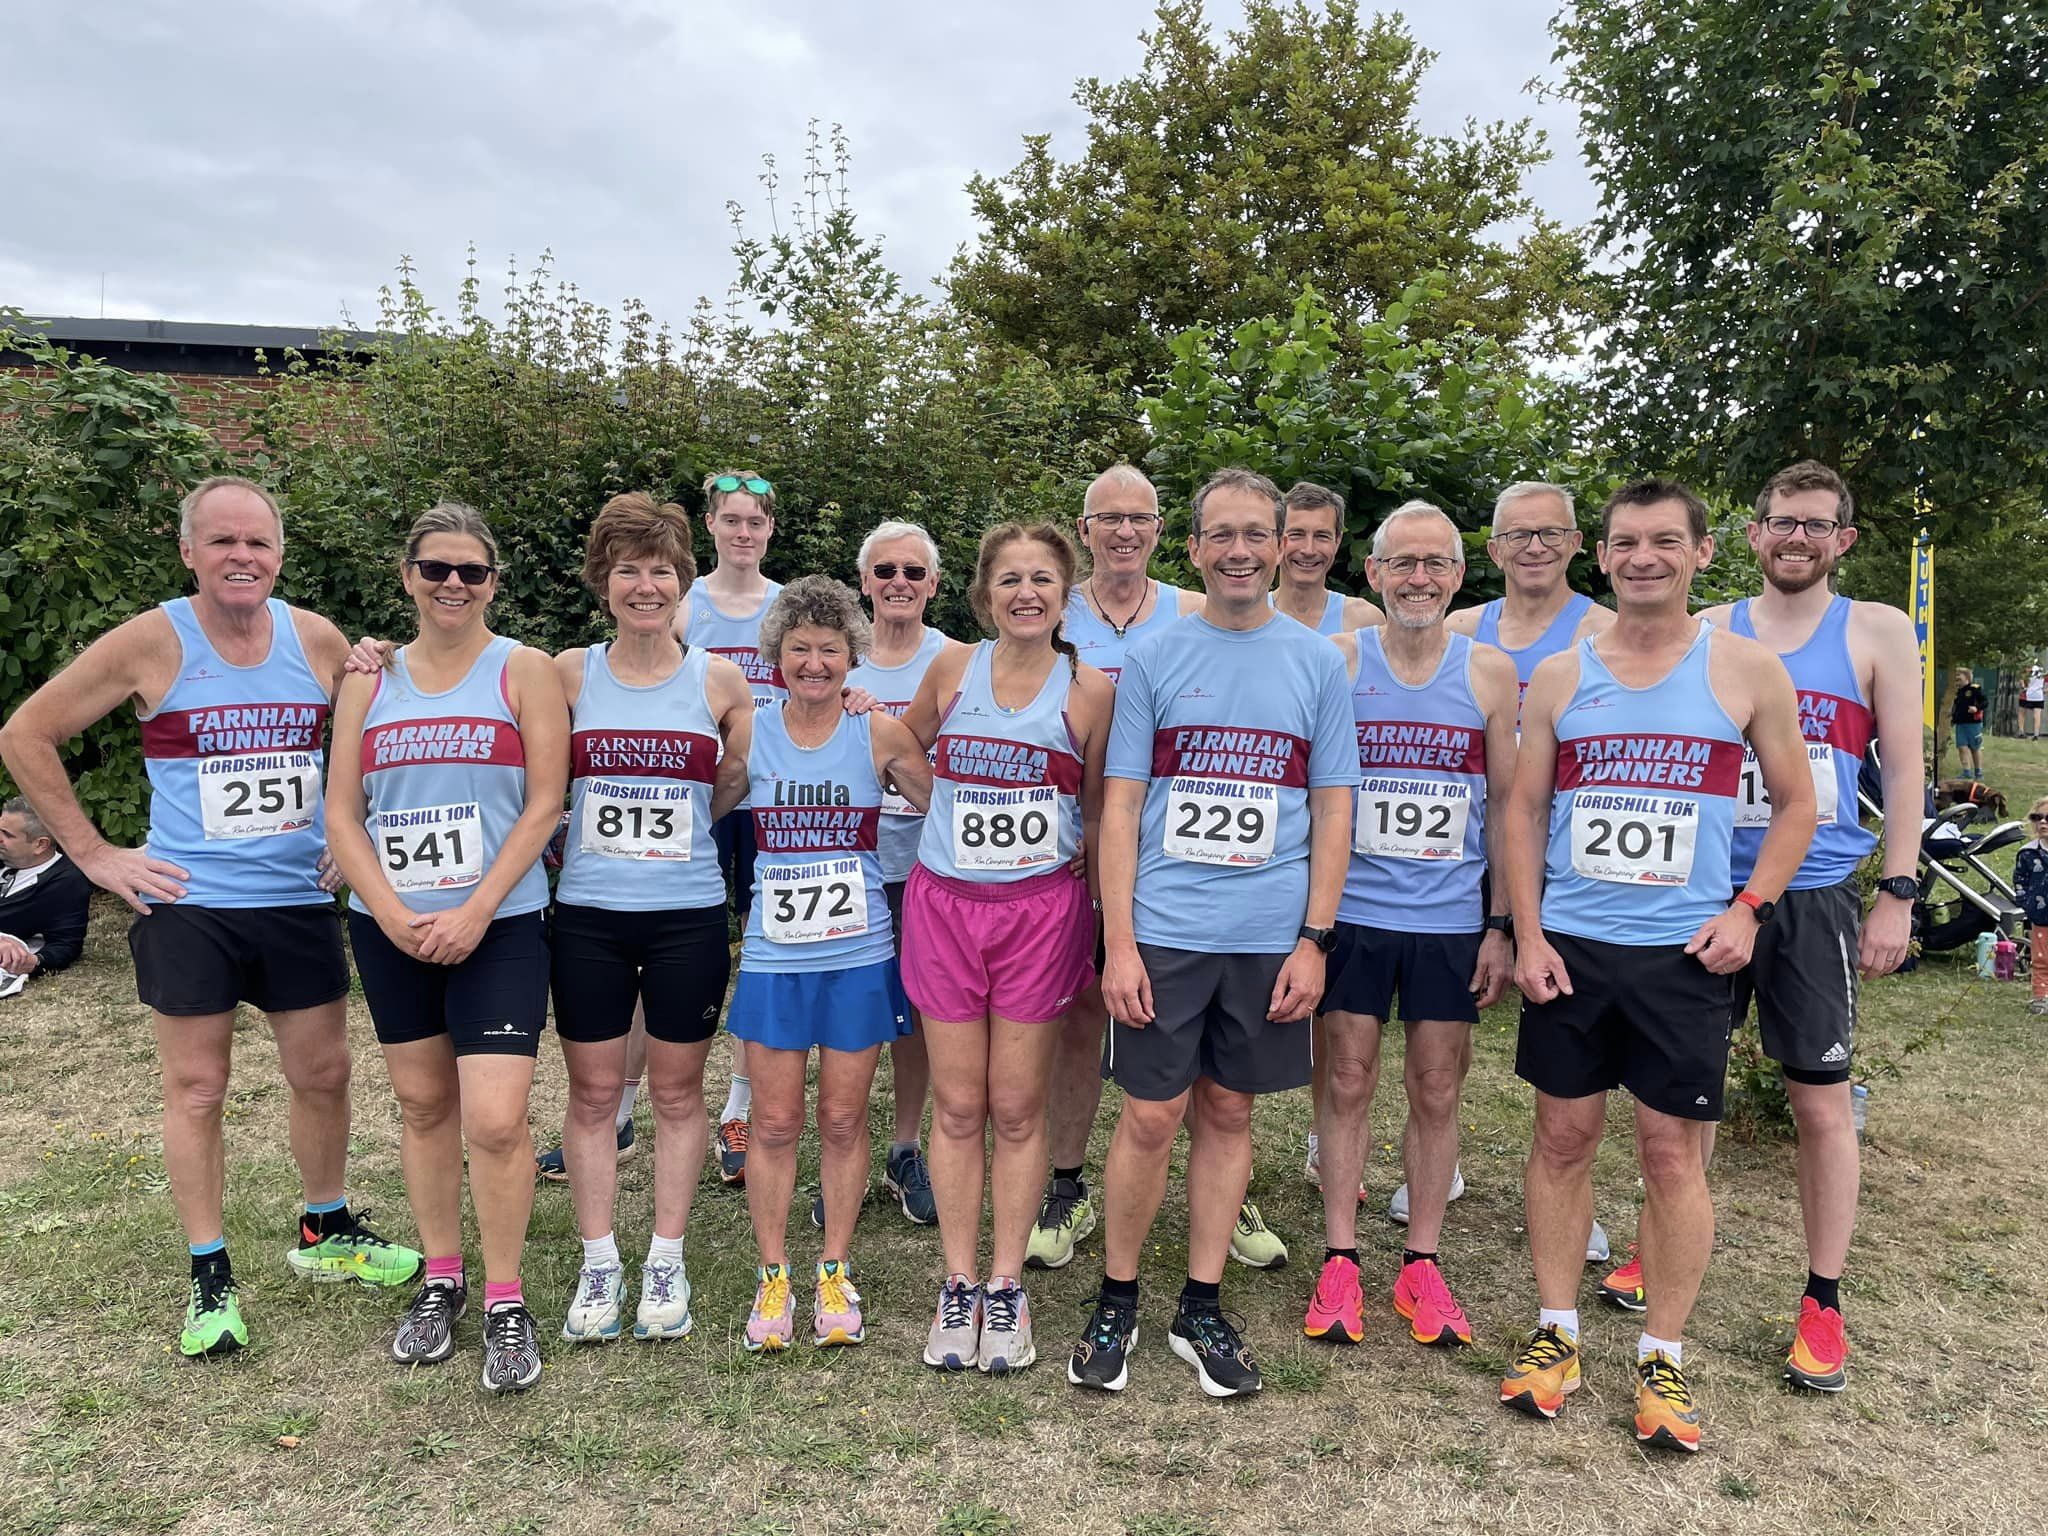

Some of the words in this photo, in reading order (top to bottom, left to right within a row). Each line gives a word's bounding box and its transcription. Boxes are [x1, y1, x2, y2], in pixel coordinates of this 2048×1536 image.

[188, 708, 317, 733] FARNHAM
[197, 728, 312, 753] RUNNERS
[373, 724, 496, 749] FARNHAM
[586, 737, 692, 755] FARNHAM
[1174, 731, 1293, 759] FARNHAM
[1357, 725, 1470, 750] FARNHAM
[375, 741, 493, 765] RUNNERS
[590, 753, 686, 769] RUNNERS
[947, 738, 1048, 769] FARNHAM
[1359, 745, 1466, 768] RUNNERS
[1574, 739, 1712, 764] FARNHAM
[201, 755, 286, 775] LORDSHILL
[288, 755, 311, 768] 10K
[949, 755, 1046, 783] RUNNERS
[1179, 752, 1288, 780] RUNNERS
[1579, 762, 1705, 787] RUNNERS
[222, 776, 303, 817] 251
[588, 779, 659, 800] LORDSHILL
[664, 787, 690, 800] 10K
[774, 780, 850, 807] Linda
[956, 790, 1025, 805] LORDSHILL
[1028, 788, 1056, 802] 10K
[1171, 779, 1245, 798] LORDSHILL
[1248, 786, 1274, 800] 10K
[1361, 778, 1438, 797] LORDSHILL
[1442, 784, 1468, 798] 10K
[445, 805, 476, 822] 10K
[1575, 794, 1658, 814] LORDSHILL
[1664, 801, 1697, 817] 10K
[597, 805, 674, 839] 813
[757, 811, 864, 829] FARNHAM
[961, 810, 1048, 848] 880
[1175, 802, 1265, 844] 229
[1374, 800, 1451, 839] 192
[386, 829, 464, 871] 541
[765, 829, 857, 848] RUNNERS
[1585, 818, 1676, 862] 201
[764, 863, 830, 881] LORDSHILL
[832, 860, 858, 874] 10K
[773, 882, 853, 923] 372
